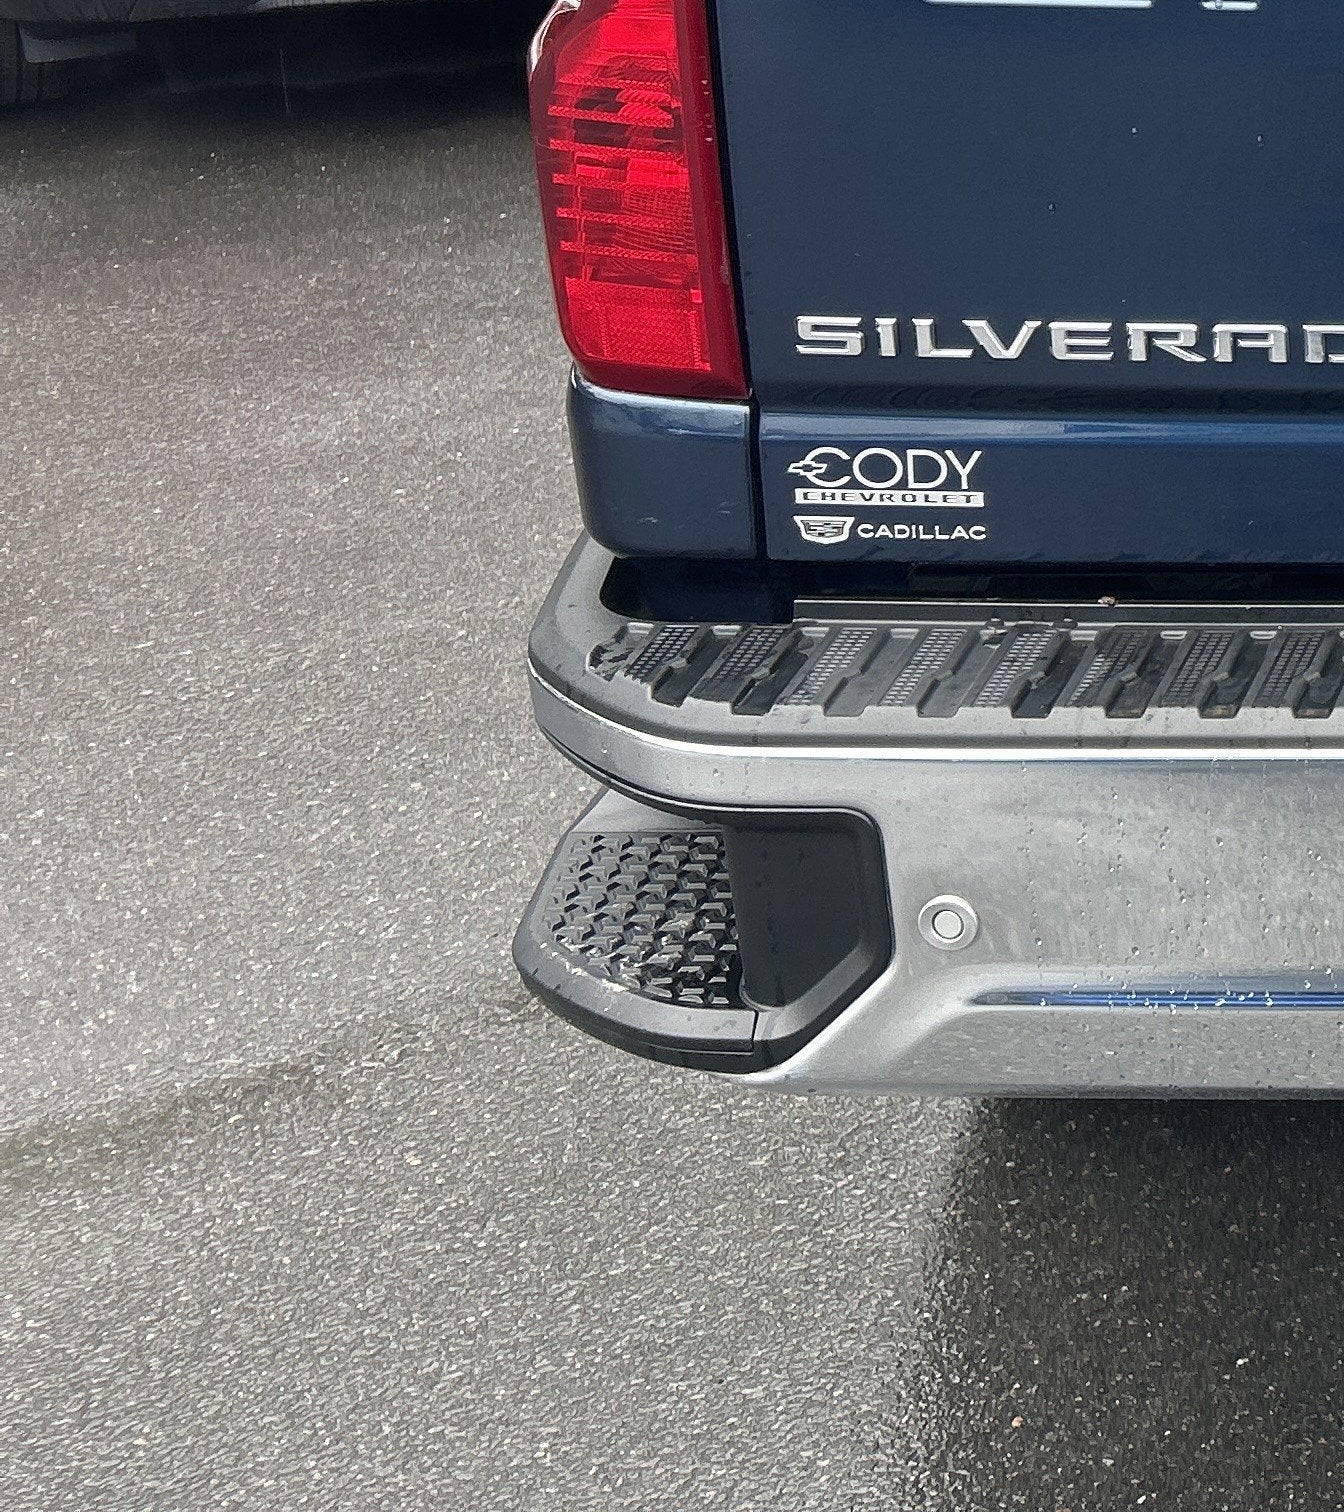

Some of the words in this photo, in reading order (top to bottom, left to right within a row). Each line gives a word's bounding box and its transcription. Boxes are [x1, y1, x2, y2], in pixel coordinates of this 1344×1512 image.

[790, 446, 983, 489] CODY
[802, 491, 978, 504] CHEVROLET
[857, 523, 987, 540] CADILLAC
